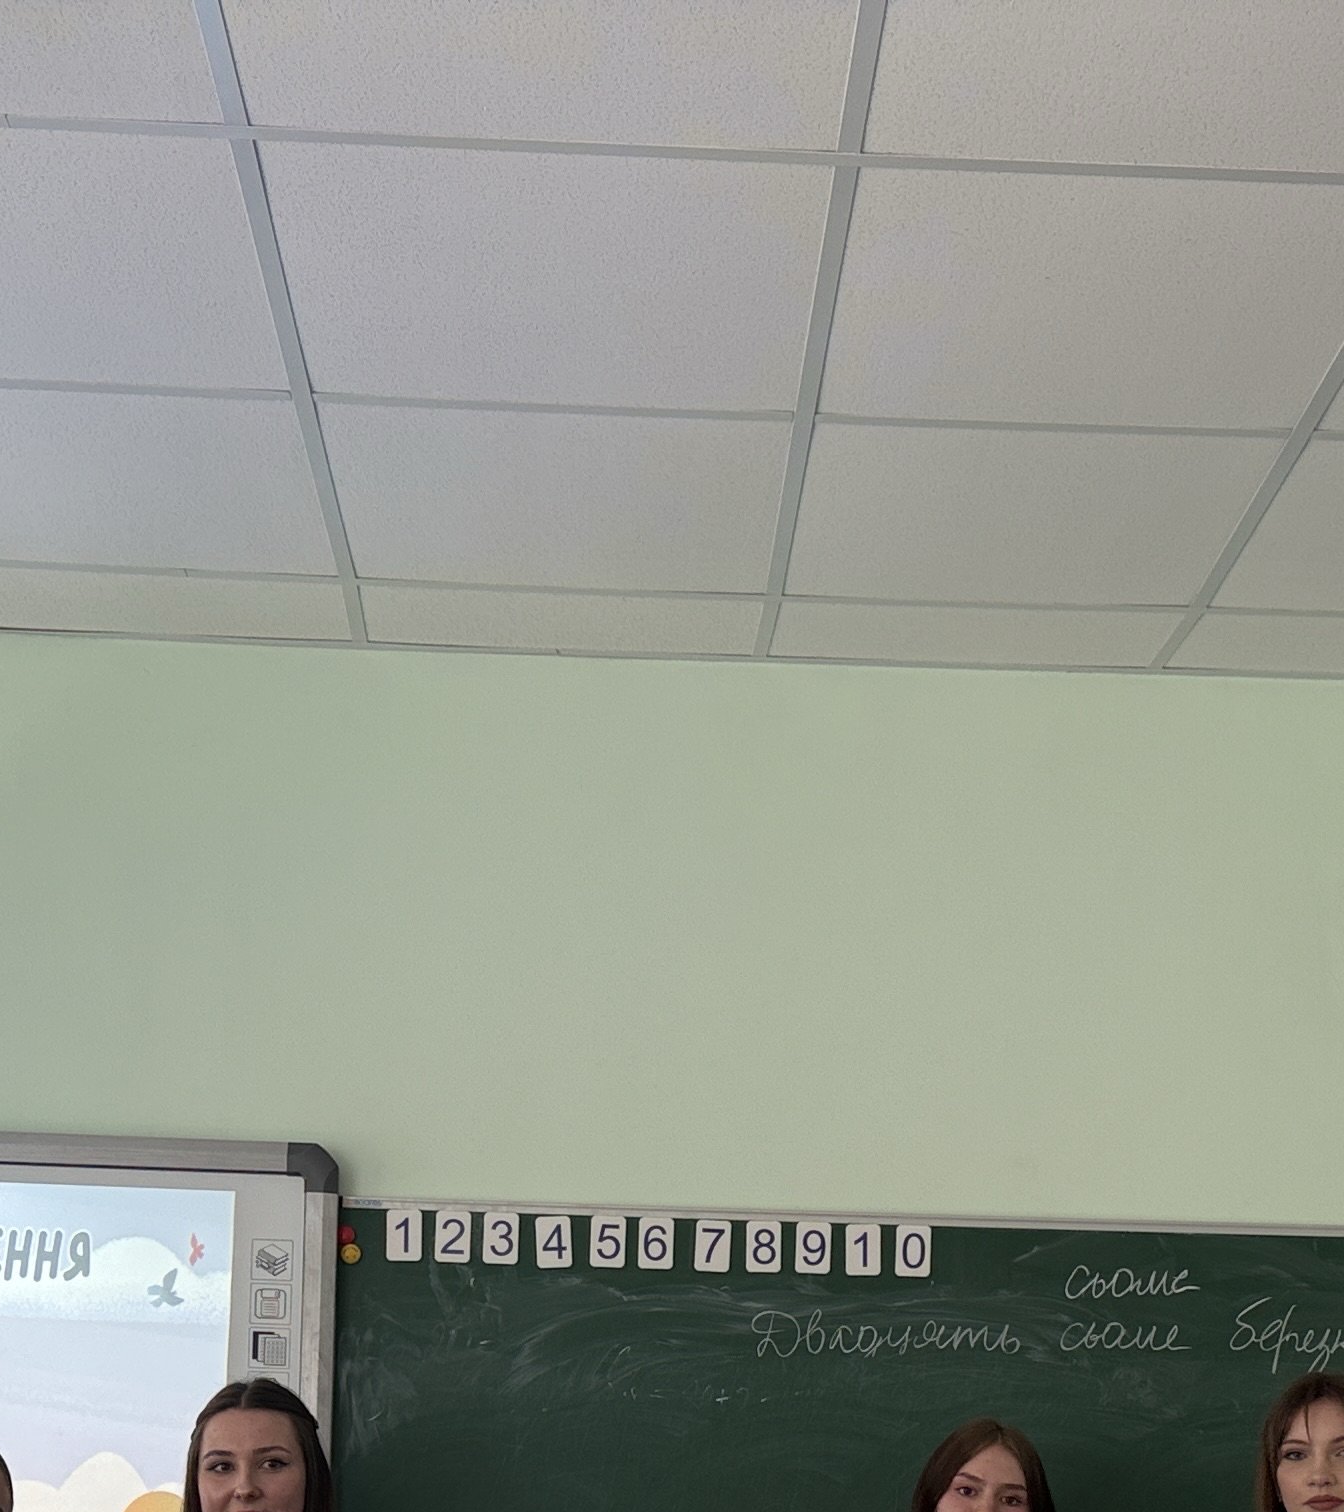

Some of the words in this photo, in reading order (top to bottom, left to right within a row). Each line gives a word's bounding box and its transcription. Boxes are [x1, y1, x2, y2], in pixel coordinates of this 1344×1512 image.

[394, 1219, 411, 1252] 1
[441, 1221, 466, 1254] 2
[490, 1221, 514, 1255] 3
[542, 1224, 567, 1258] 4
[597, 1224, 620, 1258] 5
[644, 1226, 667, 1261] 6
[702, 1228, 726, 1262] 7
[752, 1229, 776, 1264] 8
[802, 1231, 825, 1265] 9
[1064, 1264, 1200, 1301] сьоме
